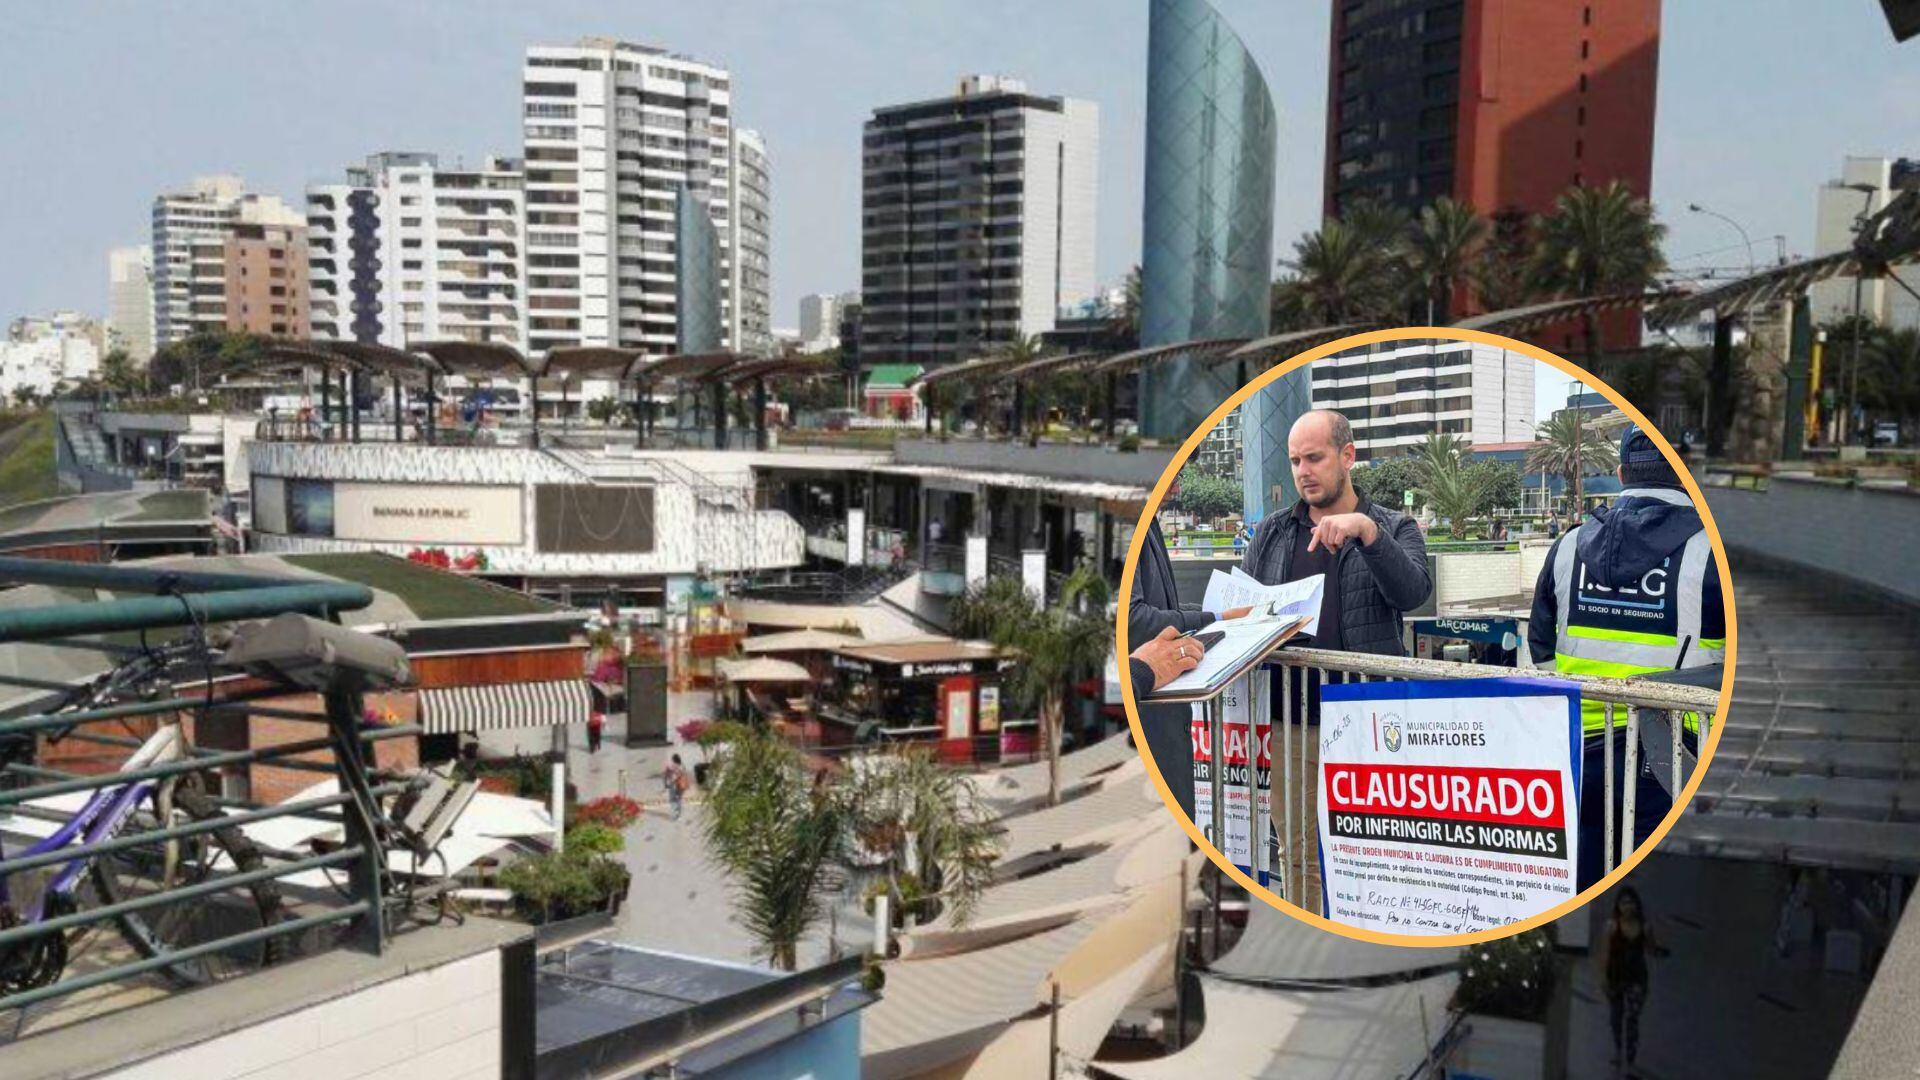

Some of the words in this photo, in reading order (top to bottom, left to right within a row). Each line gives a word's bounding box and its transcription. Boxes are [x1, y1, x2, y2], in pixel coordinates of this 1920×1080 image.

[1588, 606, 1609, 614] SOCIO
[1611, 607, 1621, 615] EN
[1623, 609, 1664, 619] SEGURIDAD
[1435, 619, 1490, 634] LARCOMAR
[1406, 721, 1470, 731] MUNICIPALIDAD
[1472, 721, 1485, 731] DE
[1407, 732, 1486, 747] MIRAFLORES
[1331, 770, 1555, 819] CLAUSURADO
[1336, 815, 1363, 834] POR
[1365, 818, 1443, 841] INFRINGIR
[1444, 823, 1476, 845] LAS
[1479, 827, 1558, 852] NORMAS
[1362, 846, 1382, 857] ORDEN
[1383, 848, 1414, 860] MUNICIPAL
[1415, 852, 1423, 861] DE
[1424, 852, 1454, 865] CLAUSURA
[1455, 856, 1463, 867] ES
[1464, 857, 1473, 868] DE
[1474, 859, 1522, 874] CUMPLIMIENTO
[1524, 864, 1569, 879] OBLIGATORIO
[1424, 866, 1432, 875] las
[1433, 868, 1456, 879] sanciones
[1505, 877, 1515, 886] sin
[1516, 879, 1542, 890] perjuicio
[1543, 881, 1551, 891] de
